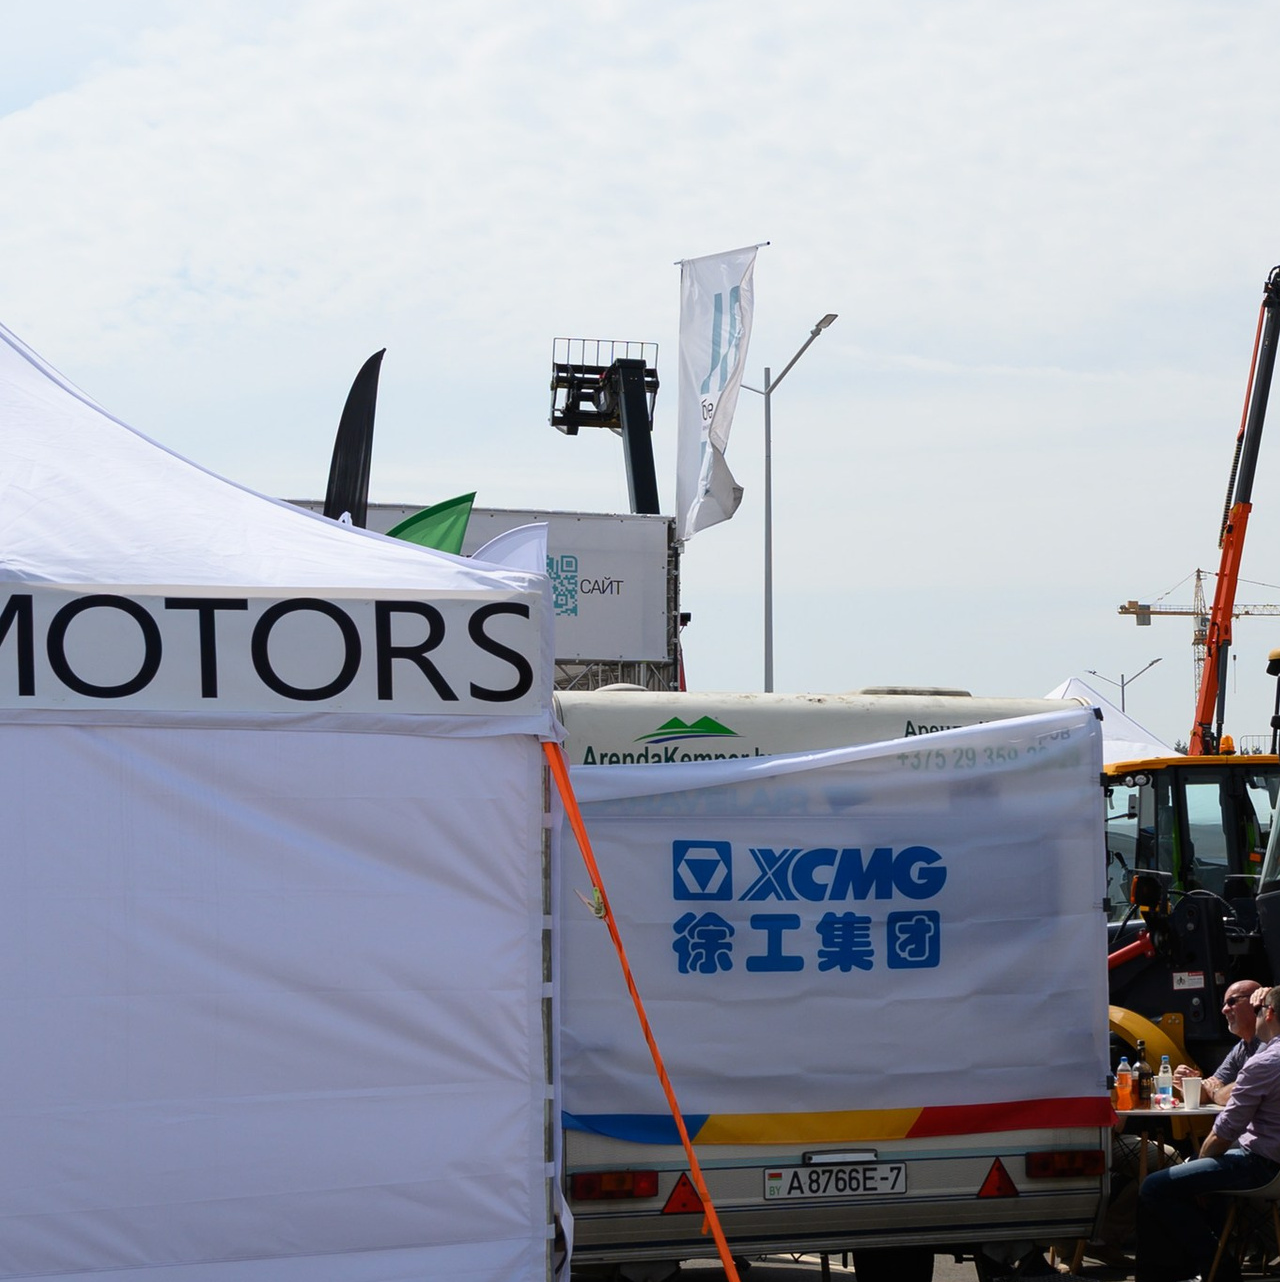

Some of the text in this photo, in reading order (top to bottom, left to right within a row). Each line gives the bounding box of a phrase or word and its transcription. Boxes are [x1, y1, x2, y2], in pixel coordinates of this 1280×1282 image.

[580, 576, 624, 595] САЙТ
[737, 846, 947, 901] XCMG
[672, 910, 941, 974] 徐工集团
[769, 1186, 782, 1197] BY
